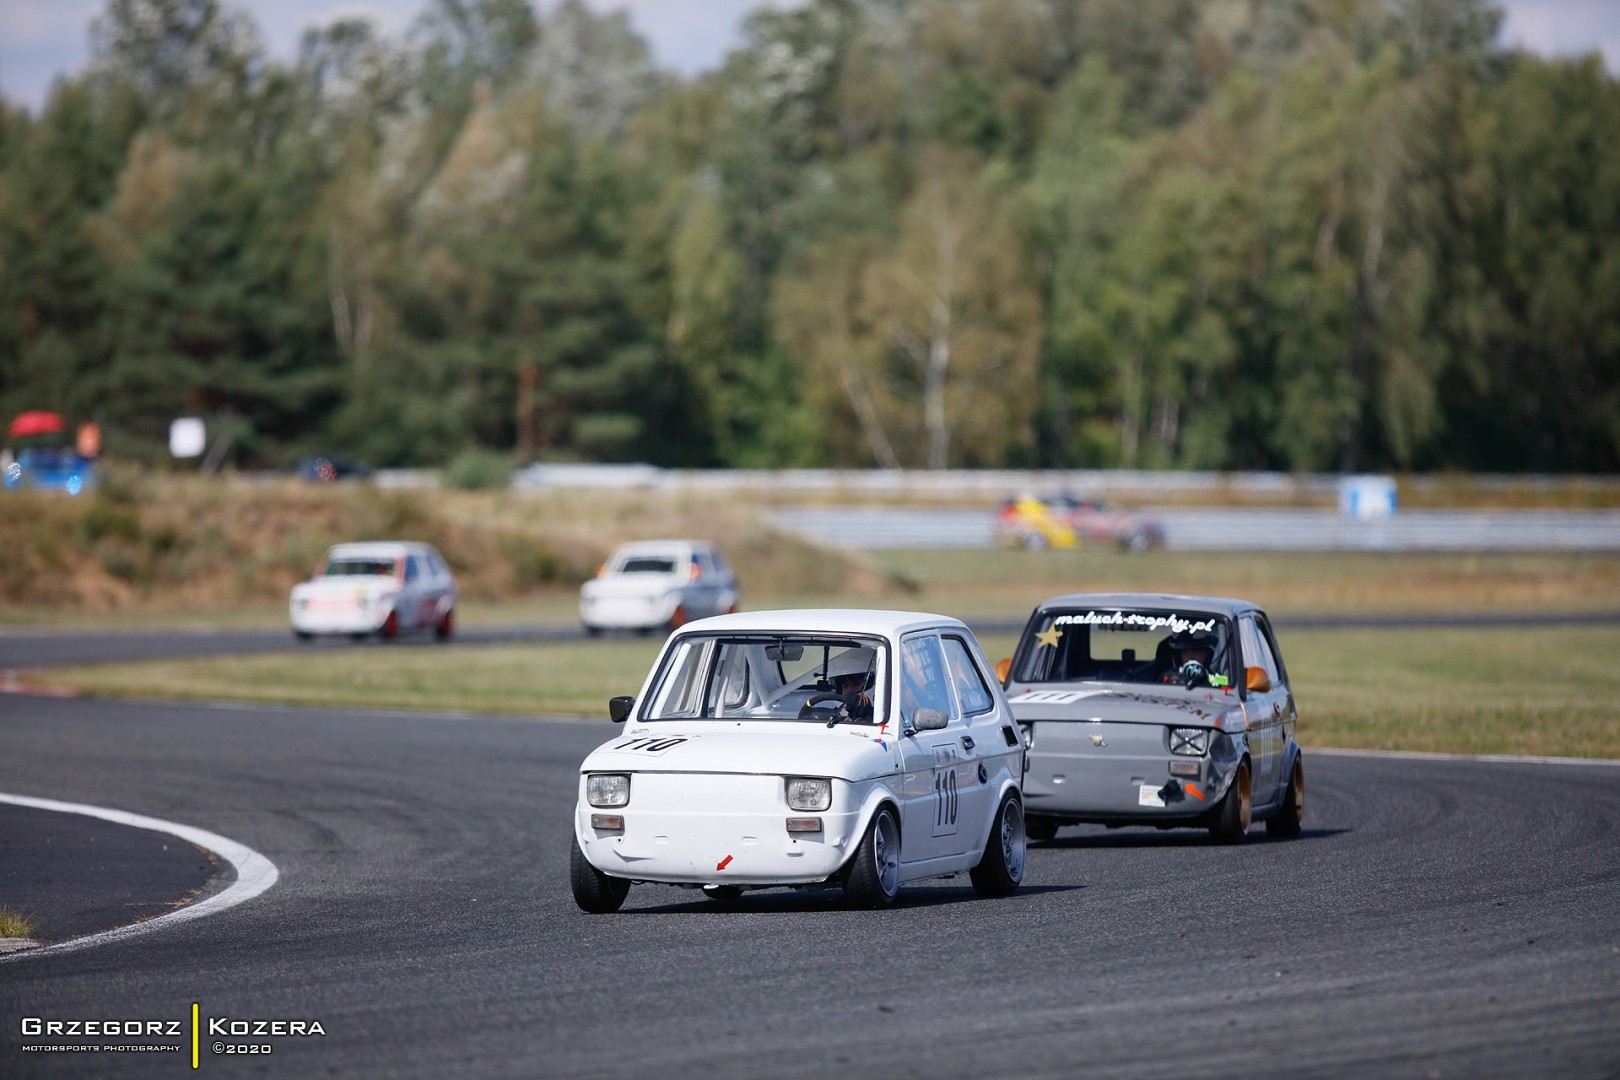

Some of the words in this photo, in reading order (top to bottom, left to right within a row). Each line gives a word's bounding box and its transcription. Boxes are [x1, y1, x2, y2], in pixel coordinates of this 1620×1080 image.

[1055, 611, 1215, 634] maluch-trophy.pl
[614, 737, 688, 751] 110
[935, 769, 958, 826] 110
